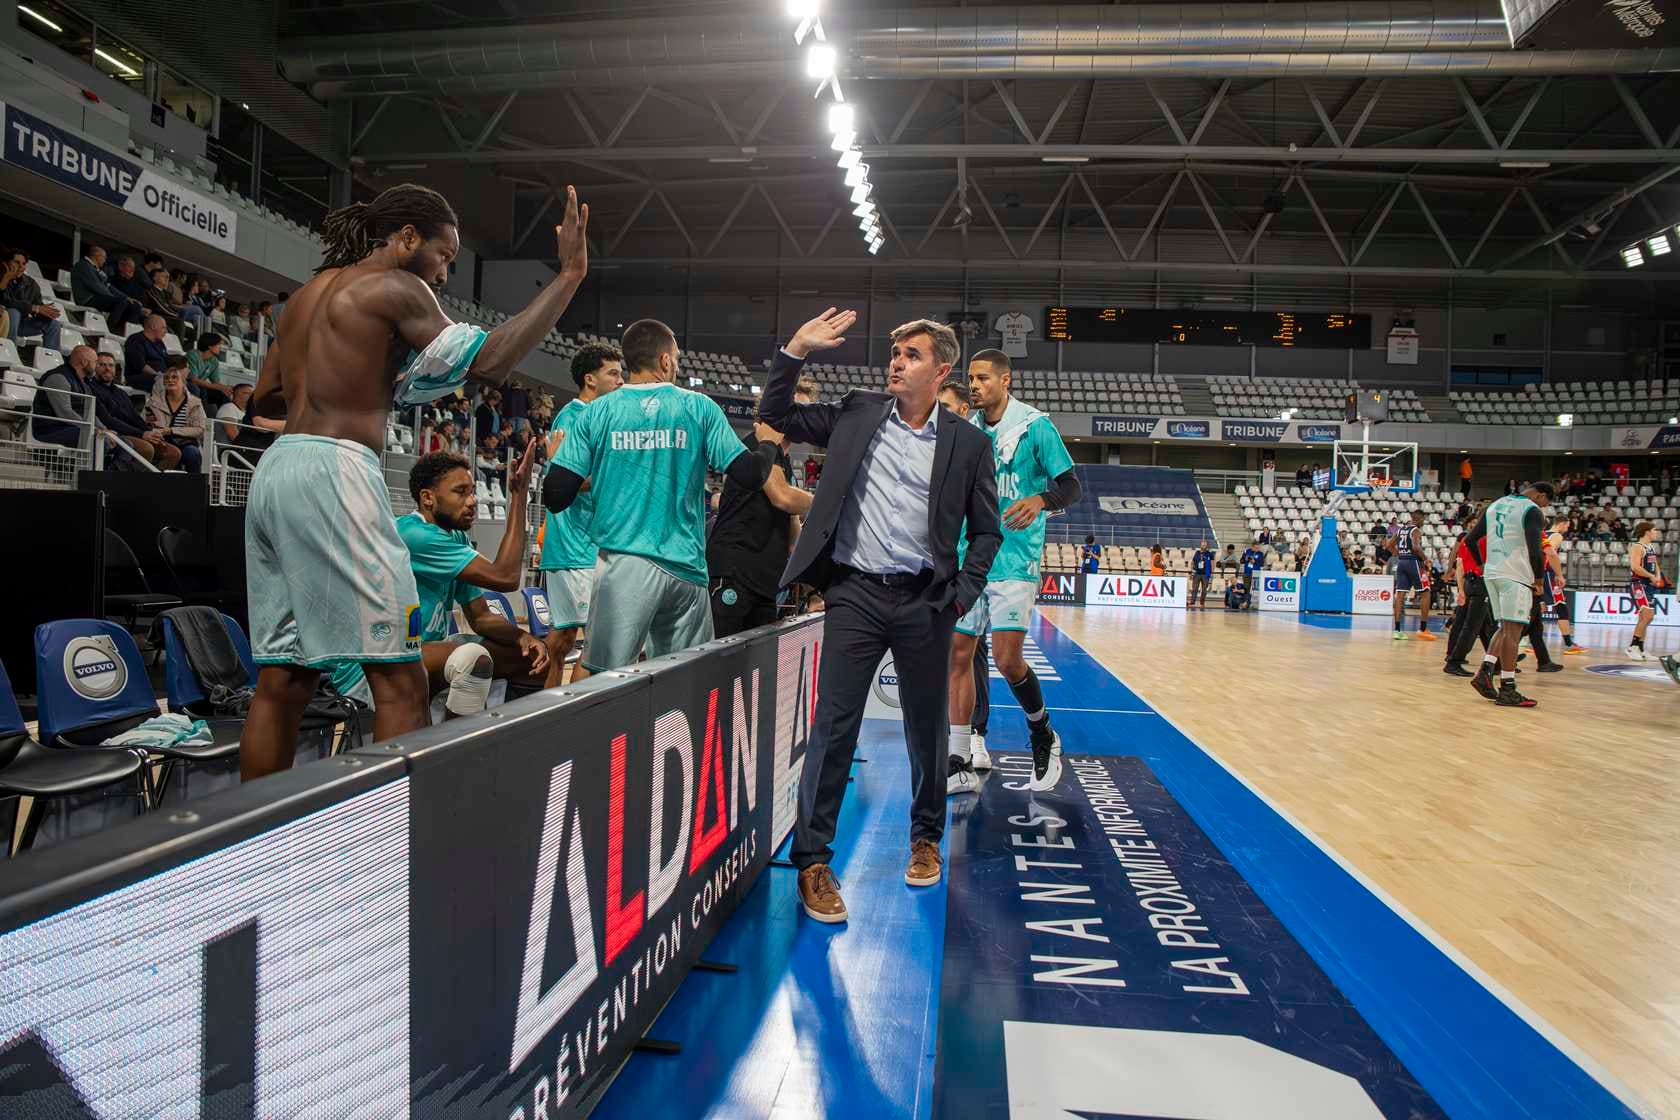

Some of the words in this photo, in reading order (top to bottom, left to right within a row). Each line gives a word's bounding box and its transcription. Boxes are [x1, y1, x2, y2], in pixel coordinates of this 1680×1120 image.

[12, 121, 134, 196] TRIBUNE
[143, 185, 228, 239] Officielle
[1095, 420, 1154, 433] TRIBUNE
[1225, 425, 1284, 437] TRIBUNE
[1398, 534, 1408, 549] 21
[1098, 577, 1176, 598] ALDAN
[1266, 578, 1294, 591] CIC
[1266, 594, 1294, 603] Ouest
[1588, 595, 1669, 616] ALDN
[75, 661, 115, 676] VOLVO
[1068, 757, 1149, 837] INFORMATIQUE
[508, 667, 761, 1074] ALDAN
[1007, 814, 1127, 988] NANTES
[1109, 838, 1221, 949] PROXIMITE
[508, 912, 683, 1120] RÉVENTION
[691, 828, 757, 929] CONSEILS
[1170, 956, 1251, 995] LA
